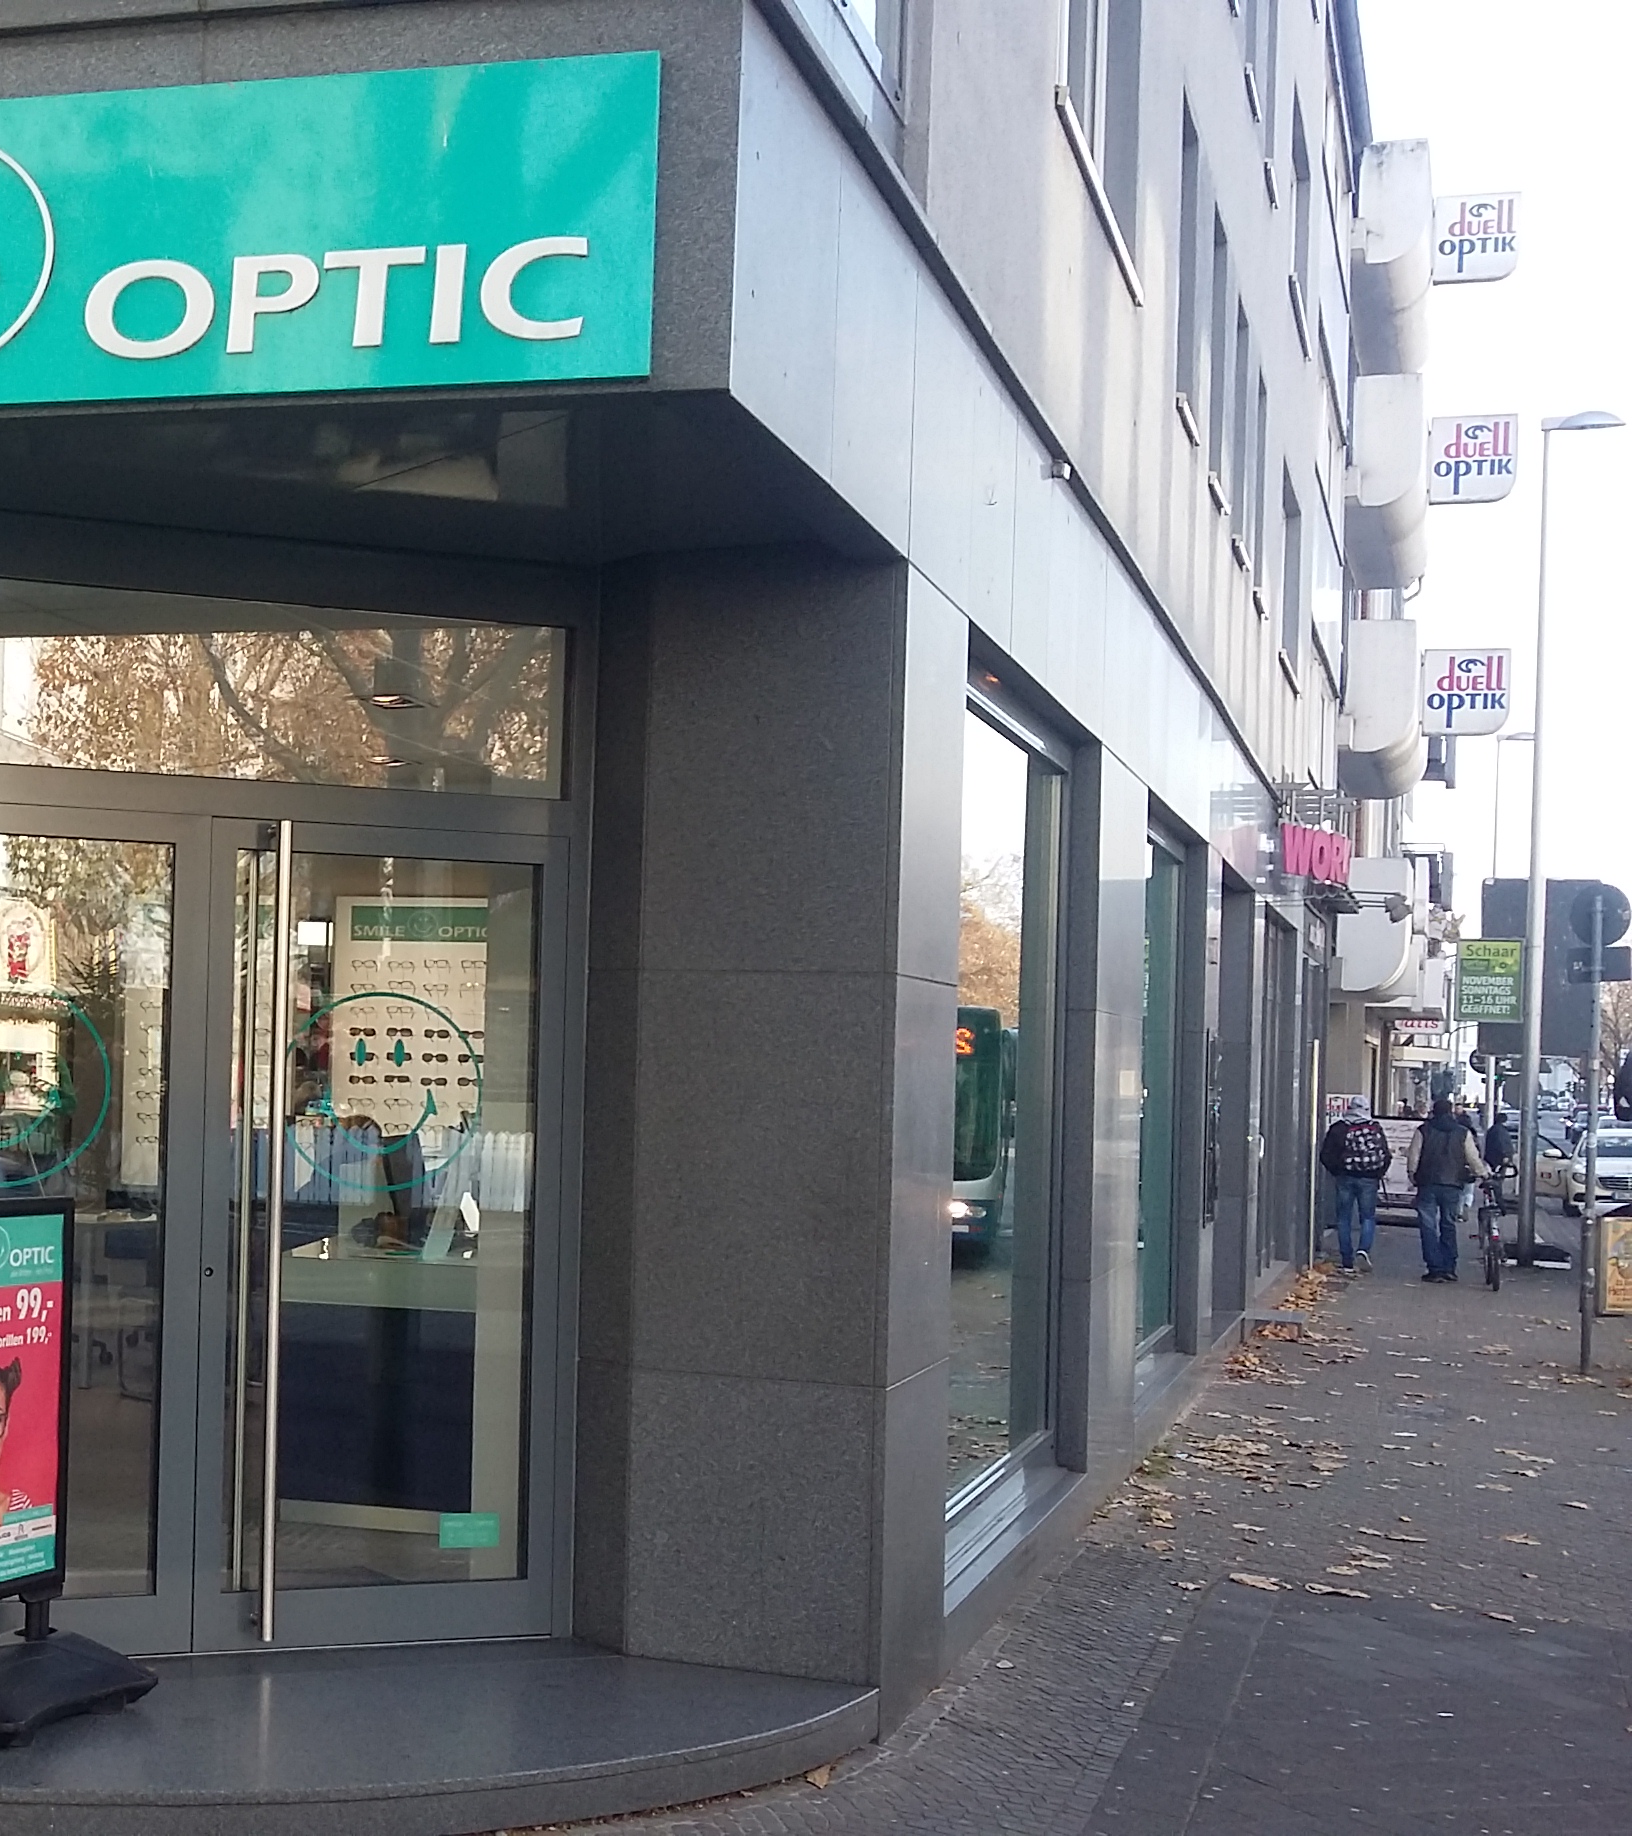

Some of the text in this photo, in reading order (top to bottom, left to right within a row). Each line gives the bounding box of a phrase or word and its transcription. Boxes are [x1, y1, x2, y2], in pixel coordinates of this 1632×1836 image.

[83, 236, 590, 361] OPTIC
[353, 925, 406, 937] SMILE
[1466, 944, 1517, 957] Schaar
[1462, 976, 1514, 986] NOVEMBER
[1461, 985, 1511, 995] SONNTAGS
[1495, 995, 1517, 1005] UHR
[9, 1246, 55, 1267] OPTIC
